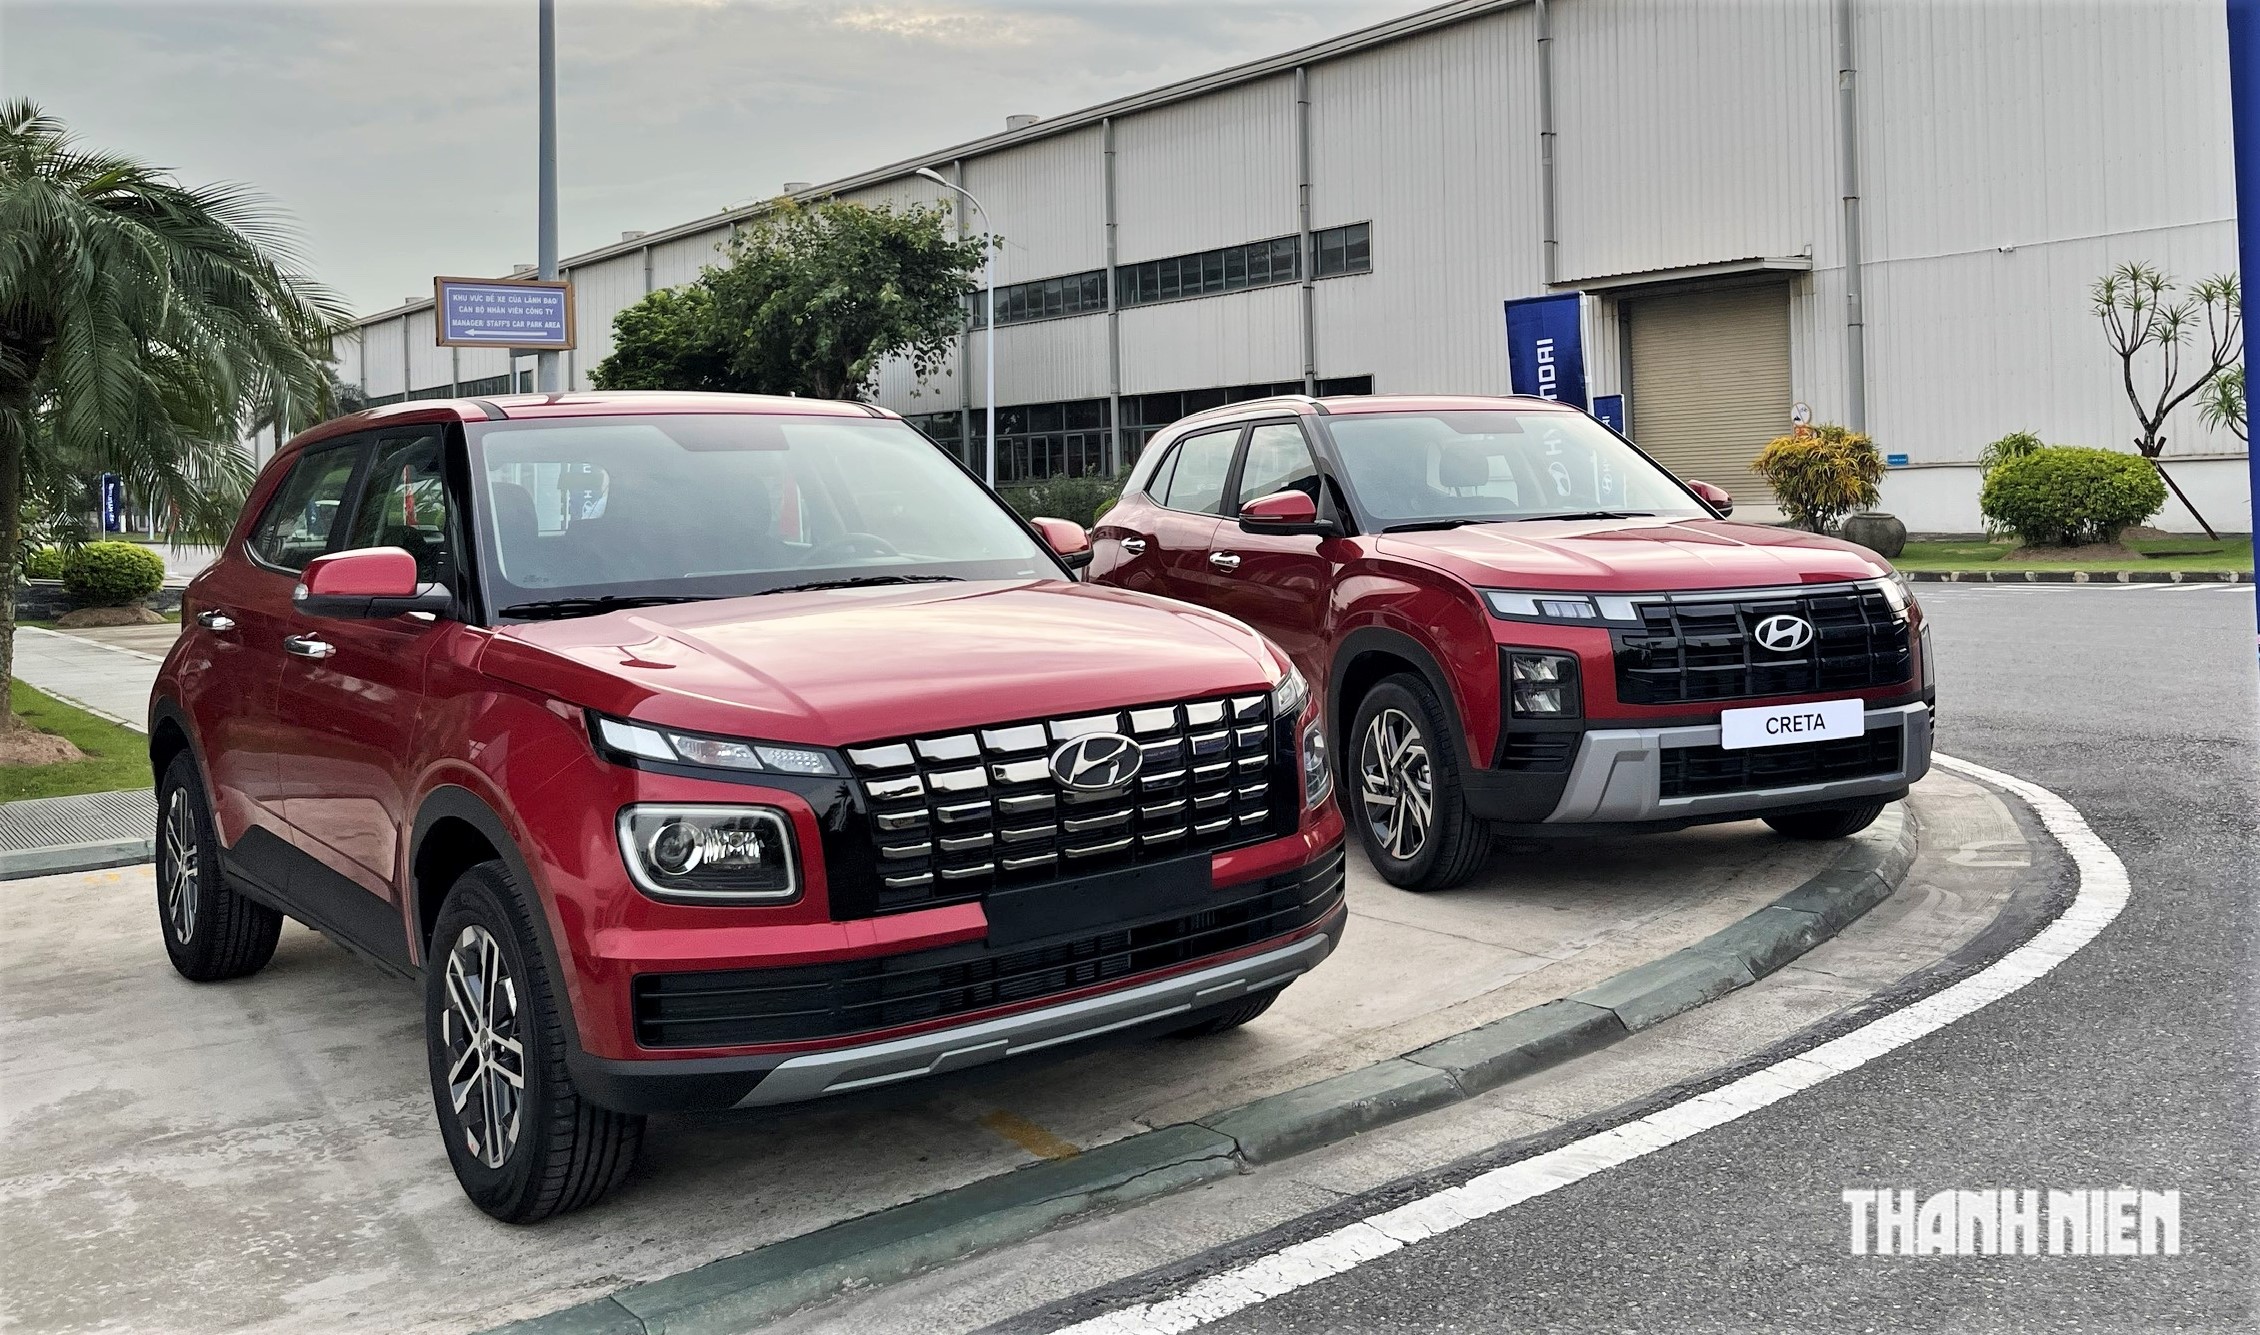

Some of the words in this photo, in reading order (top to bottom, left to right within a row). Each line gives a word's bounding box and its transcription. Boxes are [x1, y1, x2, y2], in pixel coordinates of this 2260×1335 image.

[453, 294, 468, 302] KHU
[545, 308, 554, 316] TY
[512, 320, 525, 328] CAR
[526, 320, 543, 328] PARK
[544, 321, 561, 329] AREA
[1765, 713, 1826, 735] CRETA
